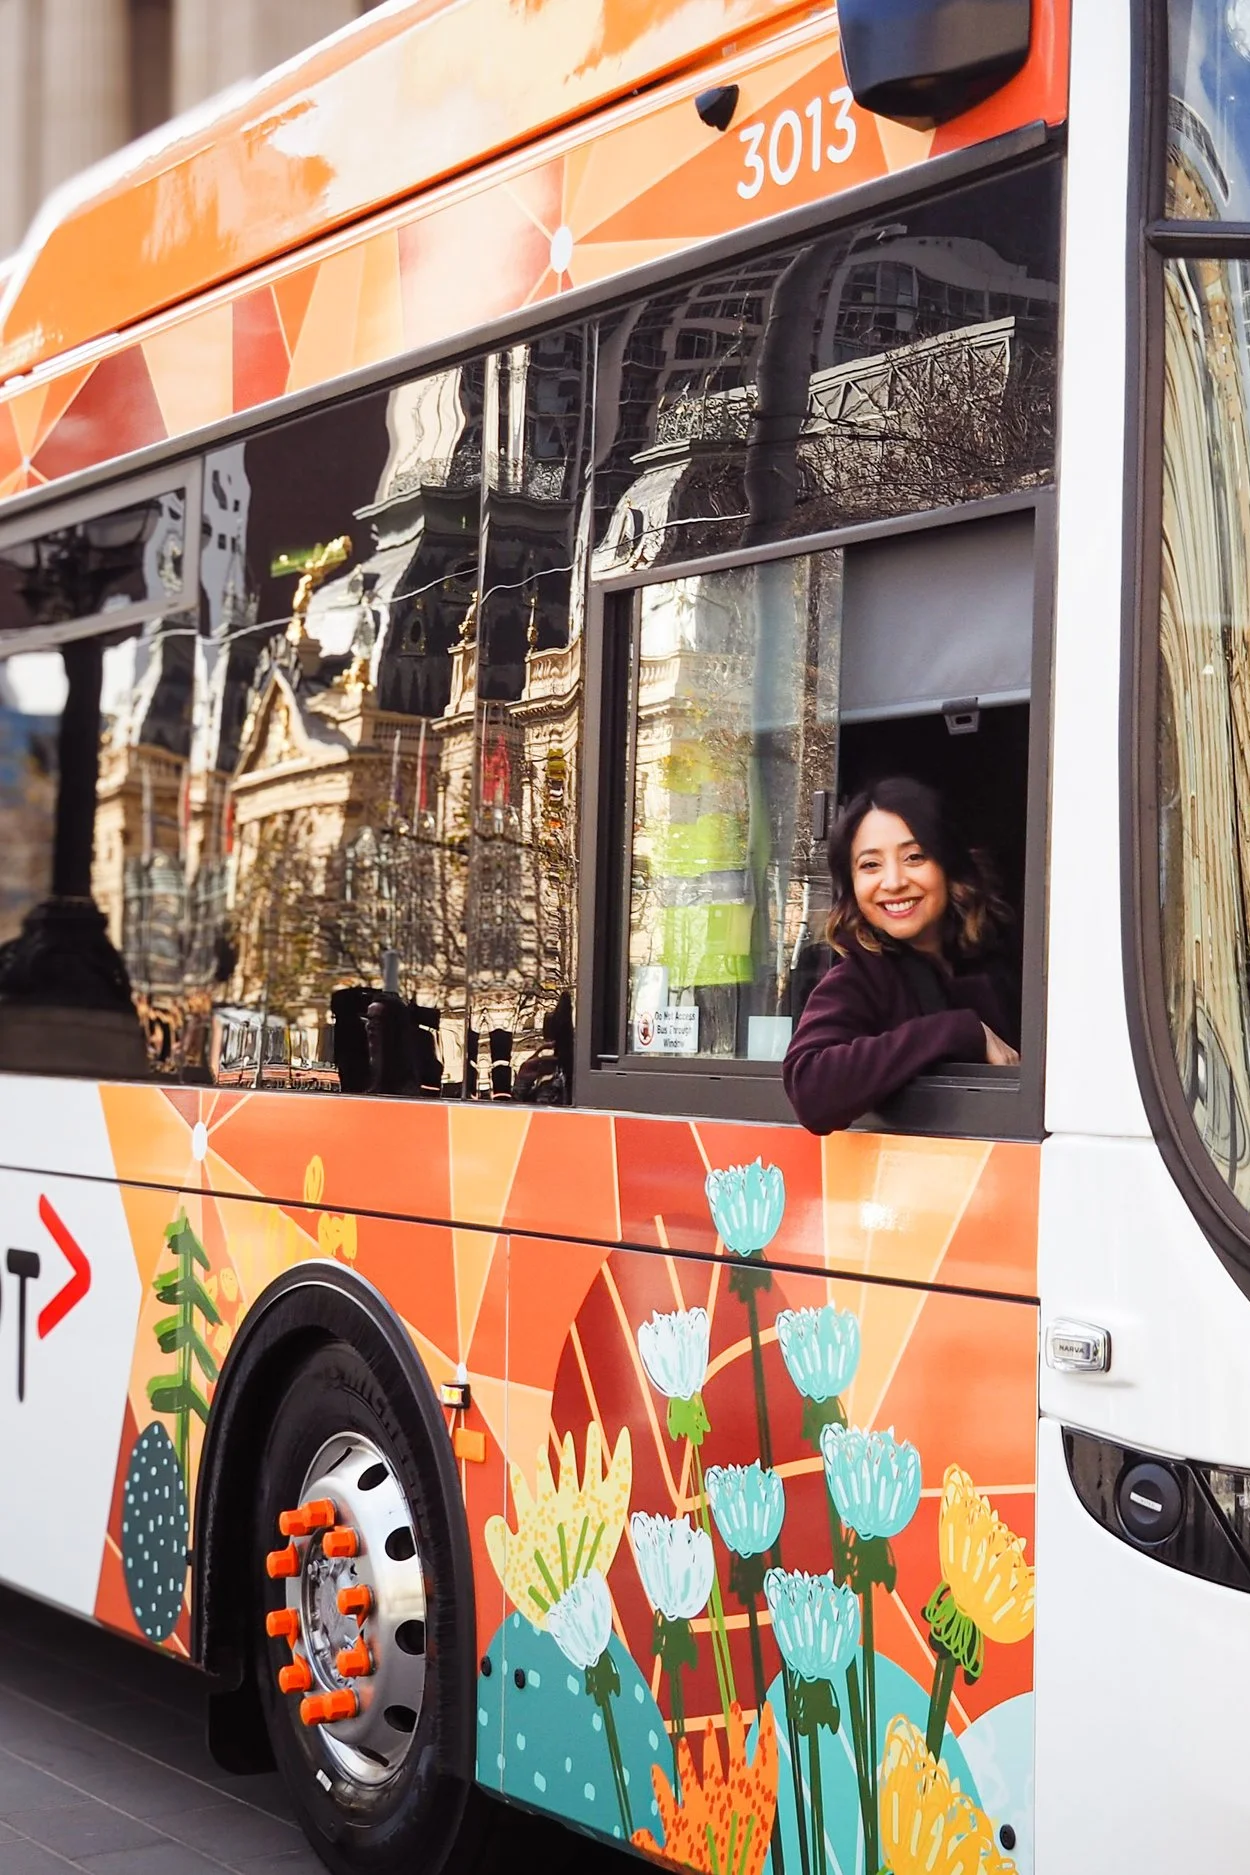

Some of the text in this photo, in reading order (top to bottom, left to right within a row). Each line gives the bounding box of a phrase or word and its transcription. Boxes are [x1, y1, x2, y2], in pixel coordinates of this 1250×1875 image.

[736, 85, 857, 200] 3013
[0, 1248, 41, 1403] T
[1059, 1344, 1085, 1354] NARVA
